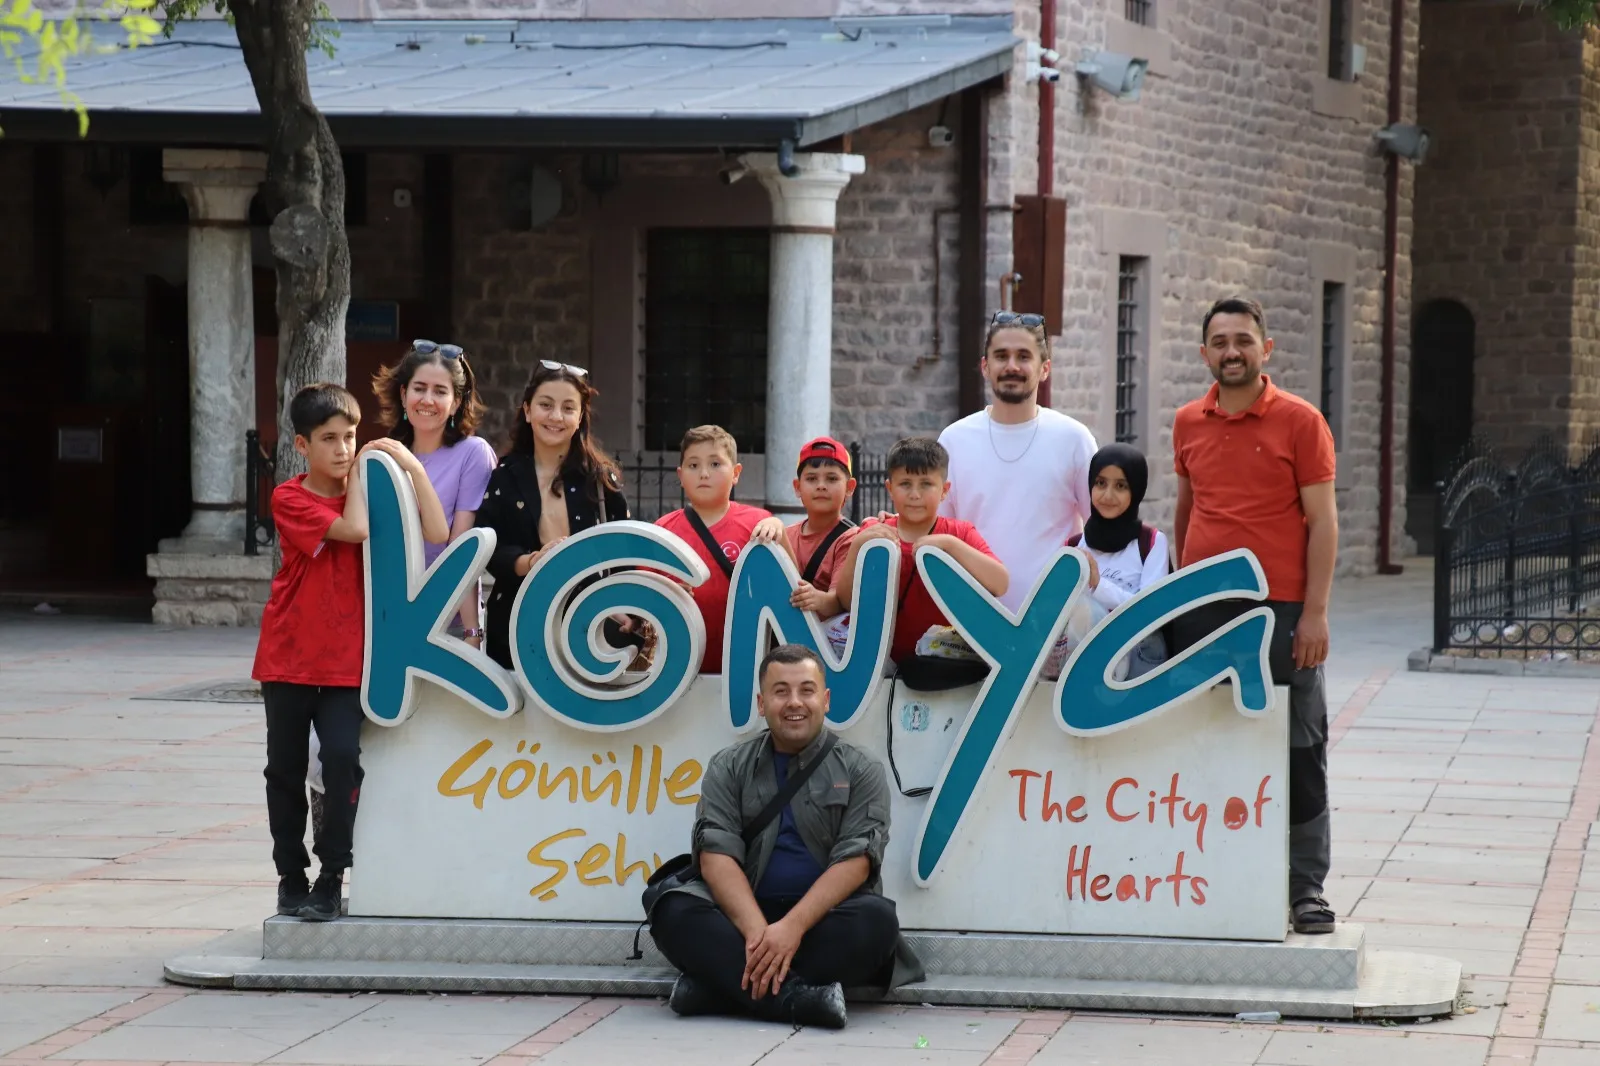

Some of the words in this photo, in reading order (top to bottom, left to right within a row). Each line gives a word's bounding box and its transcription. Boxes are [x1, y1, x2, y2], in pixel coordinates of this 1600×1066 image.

[437, 739, 703, 815] Gönülle
[1008, 769, 1087, 823] The
[1106, 773, 1208, 853] City
[1223, 775, 1272, 830] of
[1066, 845, 1208, 906] Hearts
